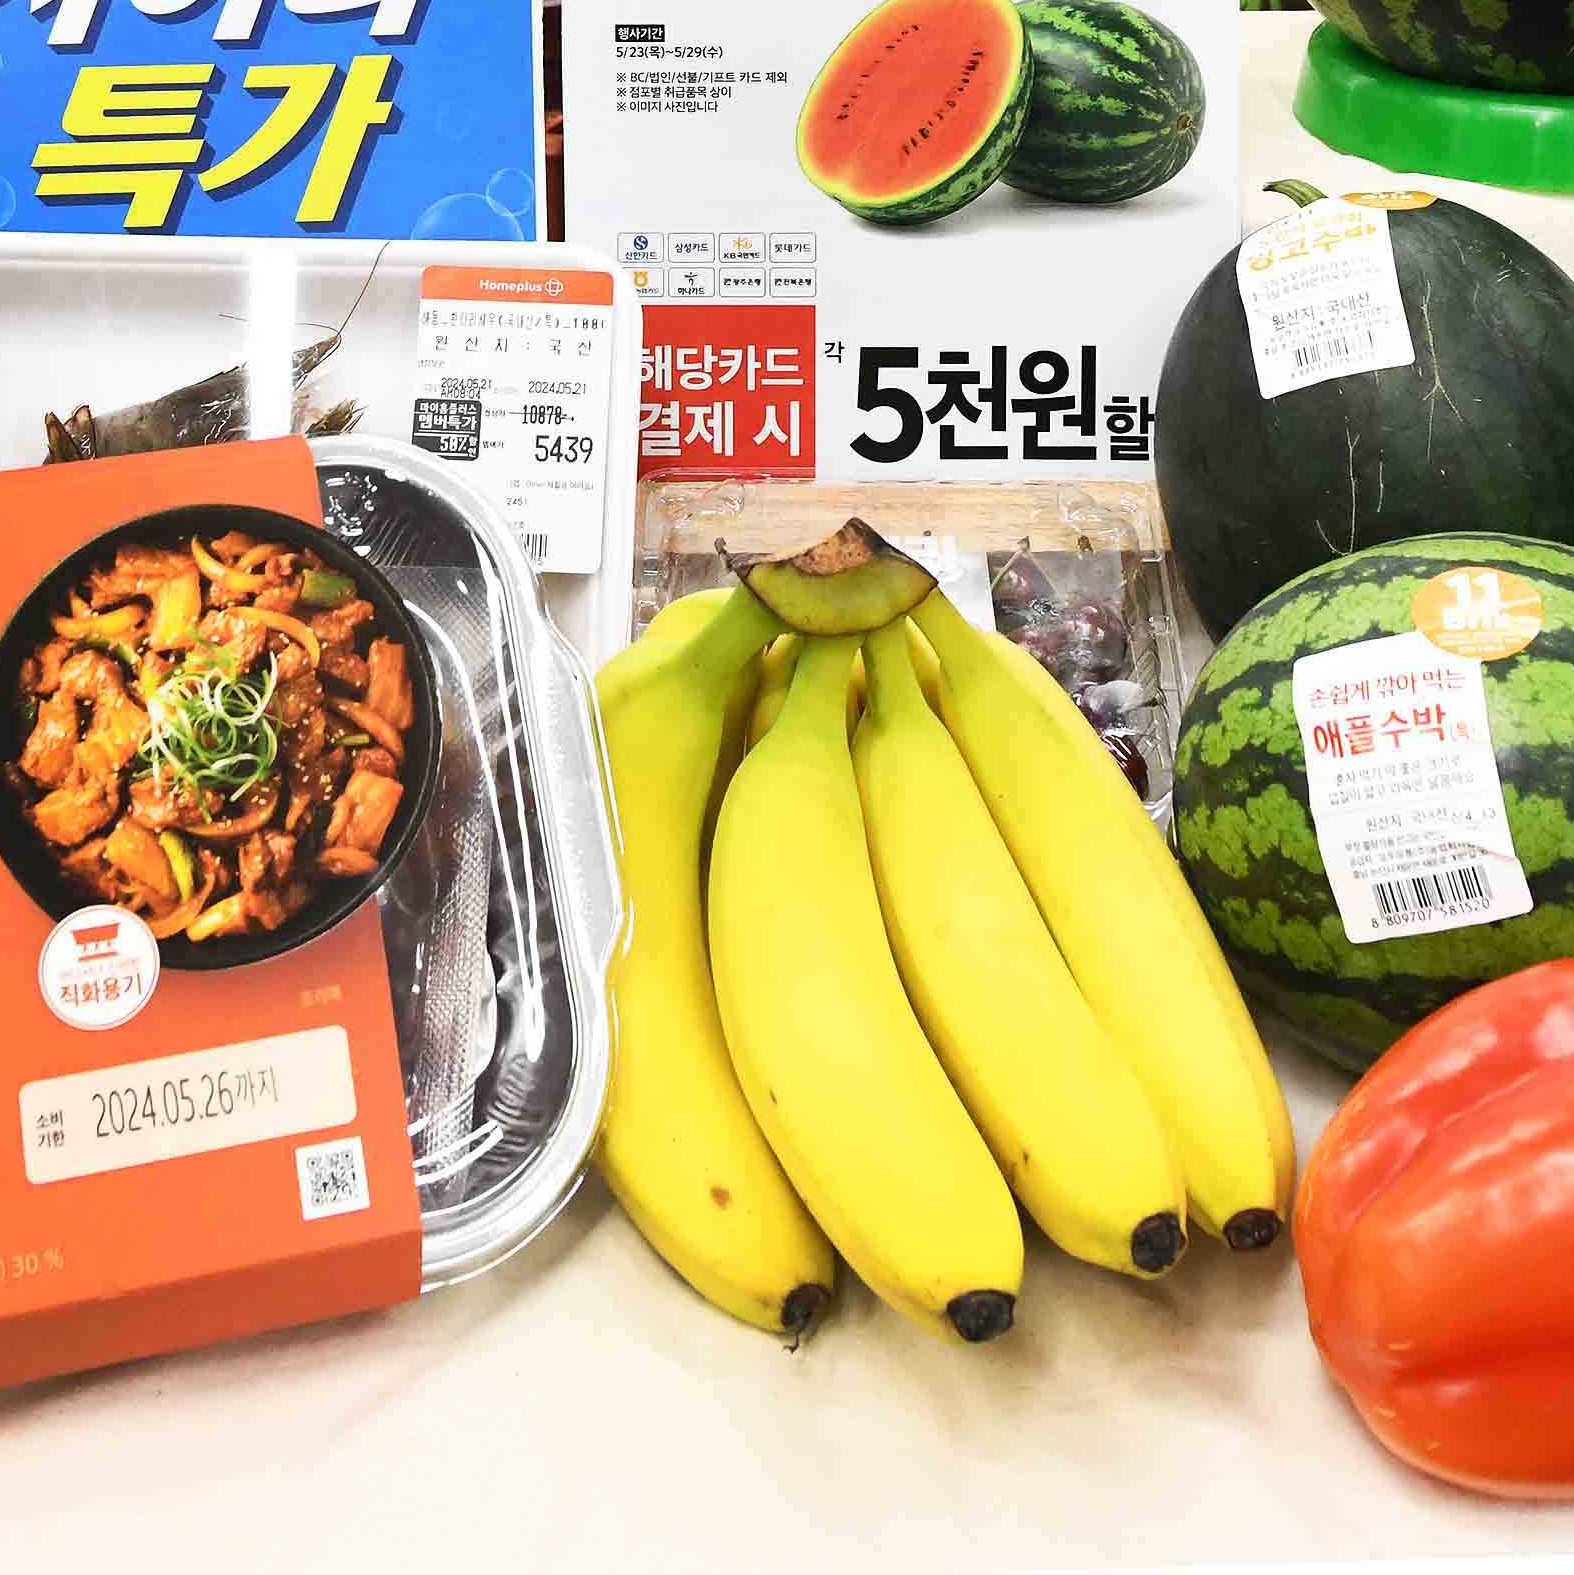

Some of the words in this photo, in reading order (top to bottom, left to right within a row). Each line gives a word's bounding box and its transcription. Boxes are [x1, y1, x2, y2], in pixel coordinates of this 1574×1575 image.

[617, 27, 663, 40] 행사기간
[739, 72, 761, 83] 카드
[765, 72, 787, 83] 제외
[629, 86, 661, 98] 점포별
[664, 86, 707, 98] 취급품목
[710, 86, 731, 98] 상이
[629, 101, 661, 112] 이미지
[664, 101, 718, 112] 사진입니다
[30, 54, 403, 234] 특가
[675, 243, 709, 253] 삼성카드
[480, 279, 542, 292] Homeplus
[824, 342, 845, 364] 각
[639, 345, 804, 392] 해당카드
[522, 405, 562, 424] 10878
[639, 401, 734, 457] 결제
[753, 401, 801, 456] 시
[535, 435, 593, 464] 5439
[1310, 681, 1370, 708] 손쉽게
[1423, 668, 1465, 690] 먹는
[1313, 704, 1447, 759] 애플수박
[1371, 918, 1379, 929] 8
[1386, 910, 1433, 925] 809707
[61, 972, 143, 1007] 직화용기
[36, 1111, 64, 1126] 소비
[38, 1132, 65, 1149] 기한
[11, 1255, 39, 1279] 30
[43, 1248, 65, 1270] %
